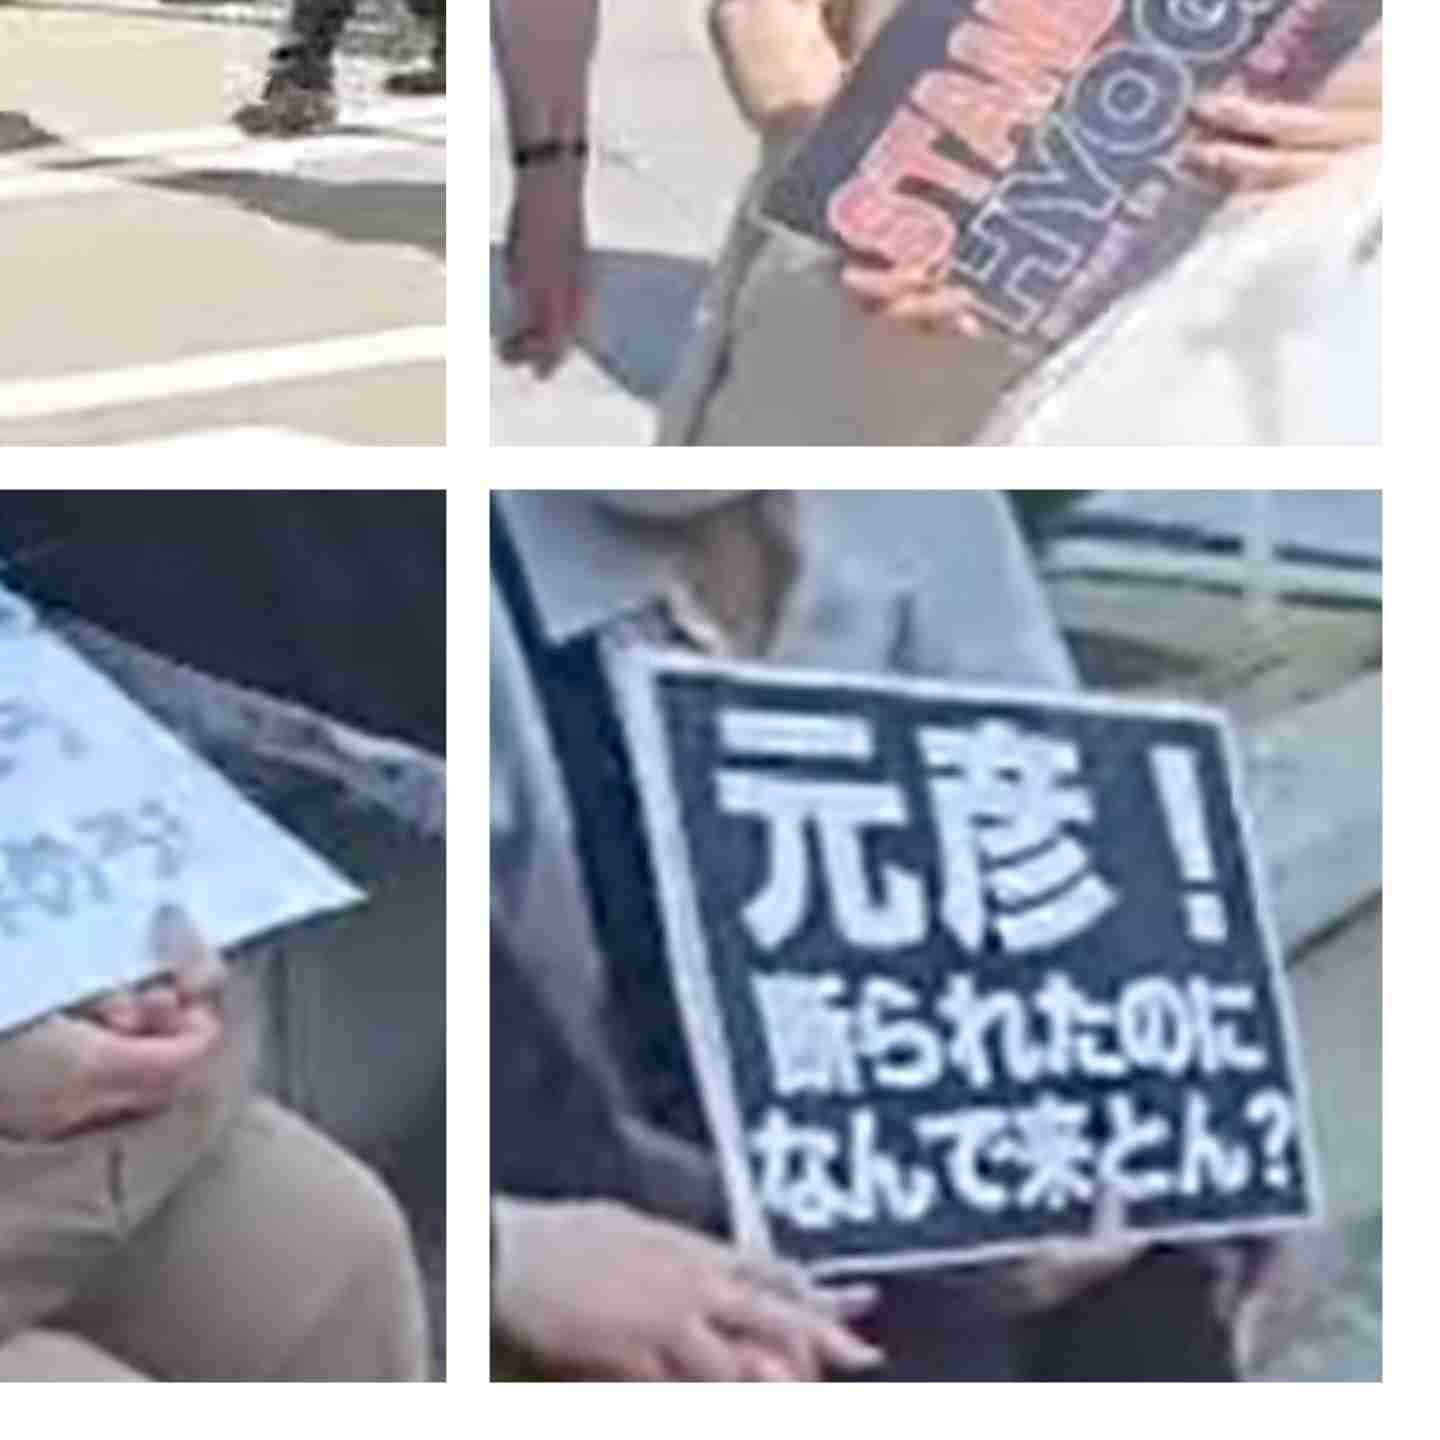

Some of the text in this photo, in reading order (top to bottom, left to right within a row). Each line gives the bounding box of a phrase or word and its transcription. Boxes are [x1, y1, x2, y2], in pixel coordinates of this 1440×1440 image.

[753, 971, 1268, 1095] 断られたのに
[749, 1091, 1293, 1228] なんで来とん?
